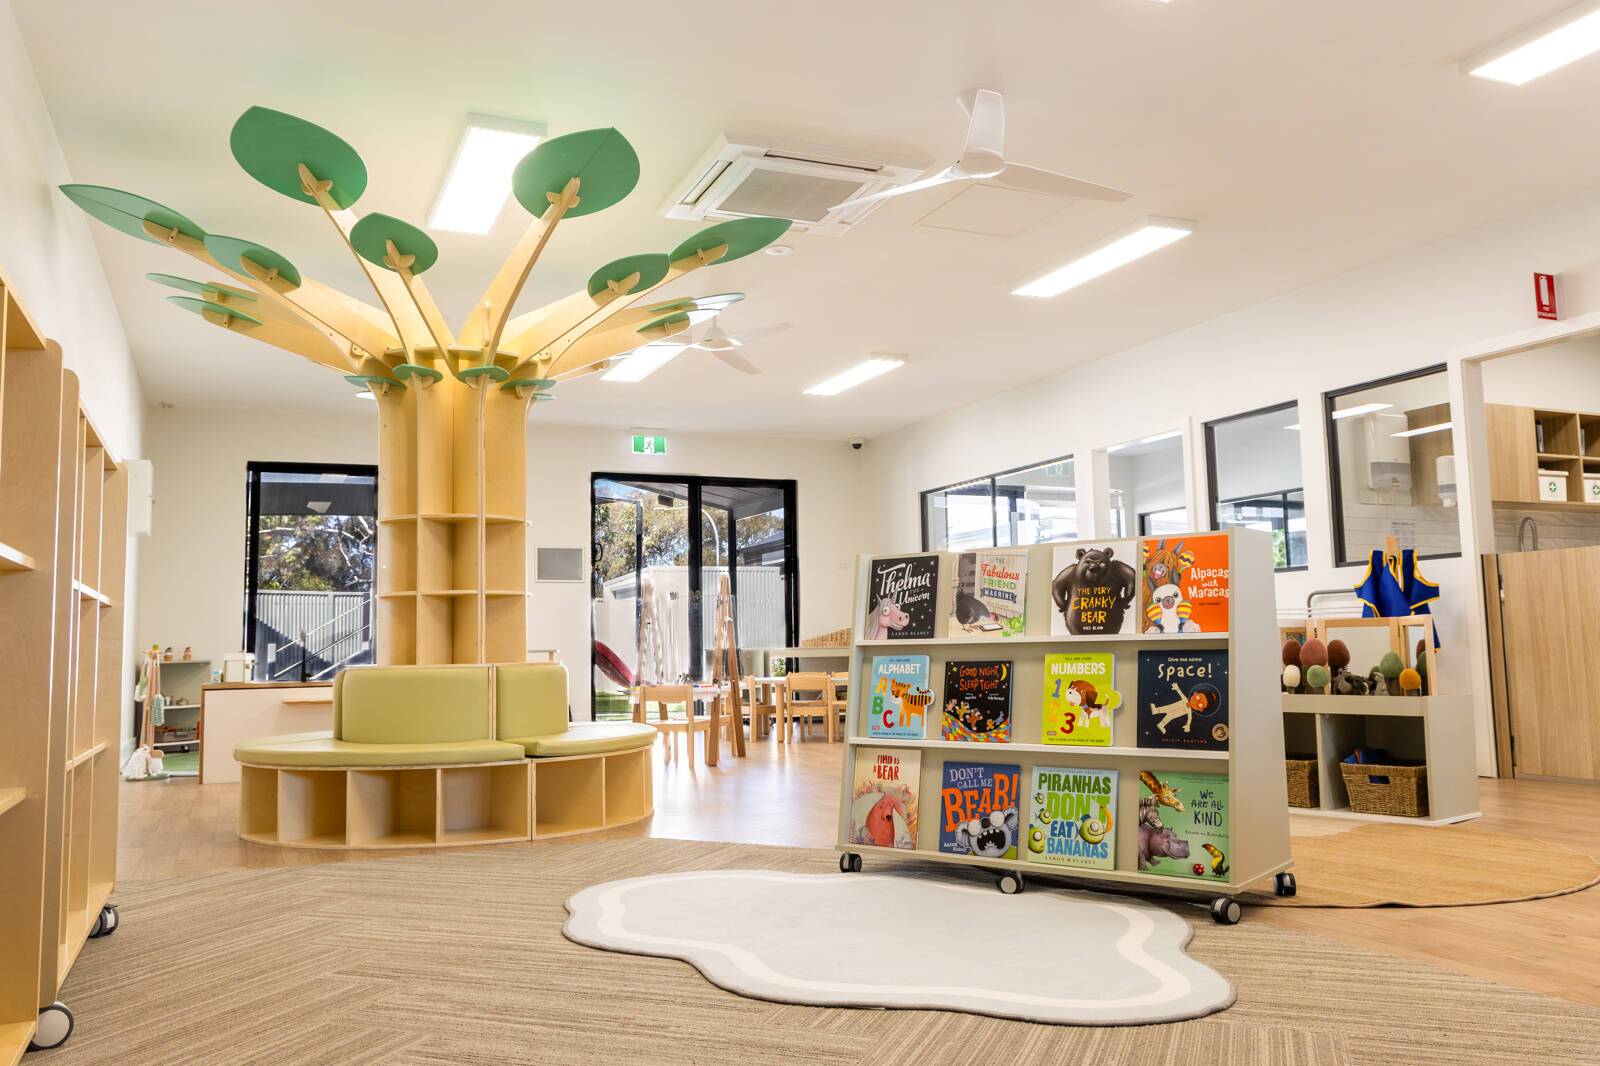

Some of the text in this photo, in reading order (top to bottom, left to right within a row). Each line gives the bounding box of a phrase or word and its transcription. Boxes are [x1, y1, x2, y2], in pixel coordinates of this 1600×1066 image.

[982, 563, 1020, 580] Fabulous
[1190, 568, 1229, 581] Alpacas
[877, 563, 931, 596] Thelma
[984, 578, 1016, 590] FRIEND
[1202, 579, 1218, 587] with
[899, 590, 930, 606] Unicorn
[1077, 586, 1112, 596] THE VERY
[1188, 586, 1230, 599] Maracas
[1071, 596, 1116, 610] CRANKY
[1080, 611, 1107, 624] BEAR
[878, 663, 921, 674] ALPHABET
[960, 666, 977, 677] GOOD
[1050, 662, 1106, 675] NUMBERS
[1158, 663, 1212, 682] Space!
[875, 676, 888, 696] A
[960, 678, 1000, 690] SLEEP TIGHT
[872, 696, 884, 715] B
[1052, 678, 1062, 698] 1
[1060, 712, 1076, 734] 3
[882, 709, 895, 728] C
[877, 765, 899, 781] BEAR
[950, 767, 984, 782] DON'T
[957, 778, 993, 789] CALL ME
[1038, 773, 1112, 795] PIRANHAS
[942, 772, 1019, 832] BEAR!
[1200, 789, 1214, 800] We
[1046, 792, 1110, 824] DON'T
[1211, 800, 1224, 811] ALL
[1194, 810, 1223, 827] KIND
[1050, 820, 1074, 838] EAT
[1046, 837, 1108, 859] BANANAS
